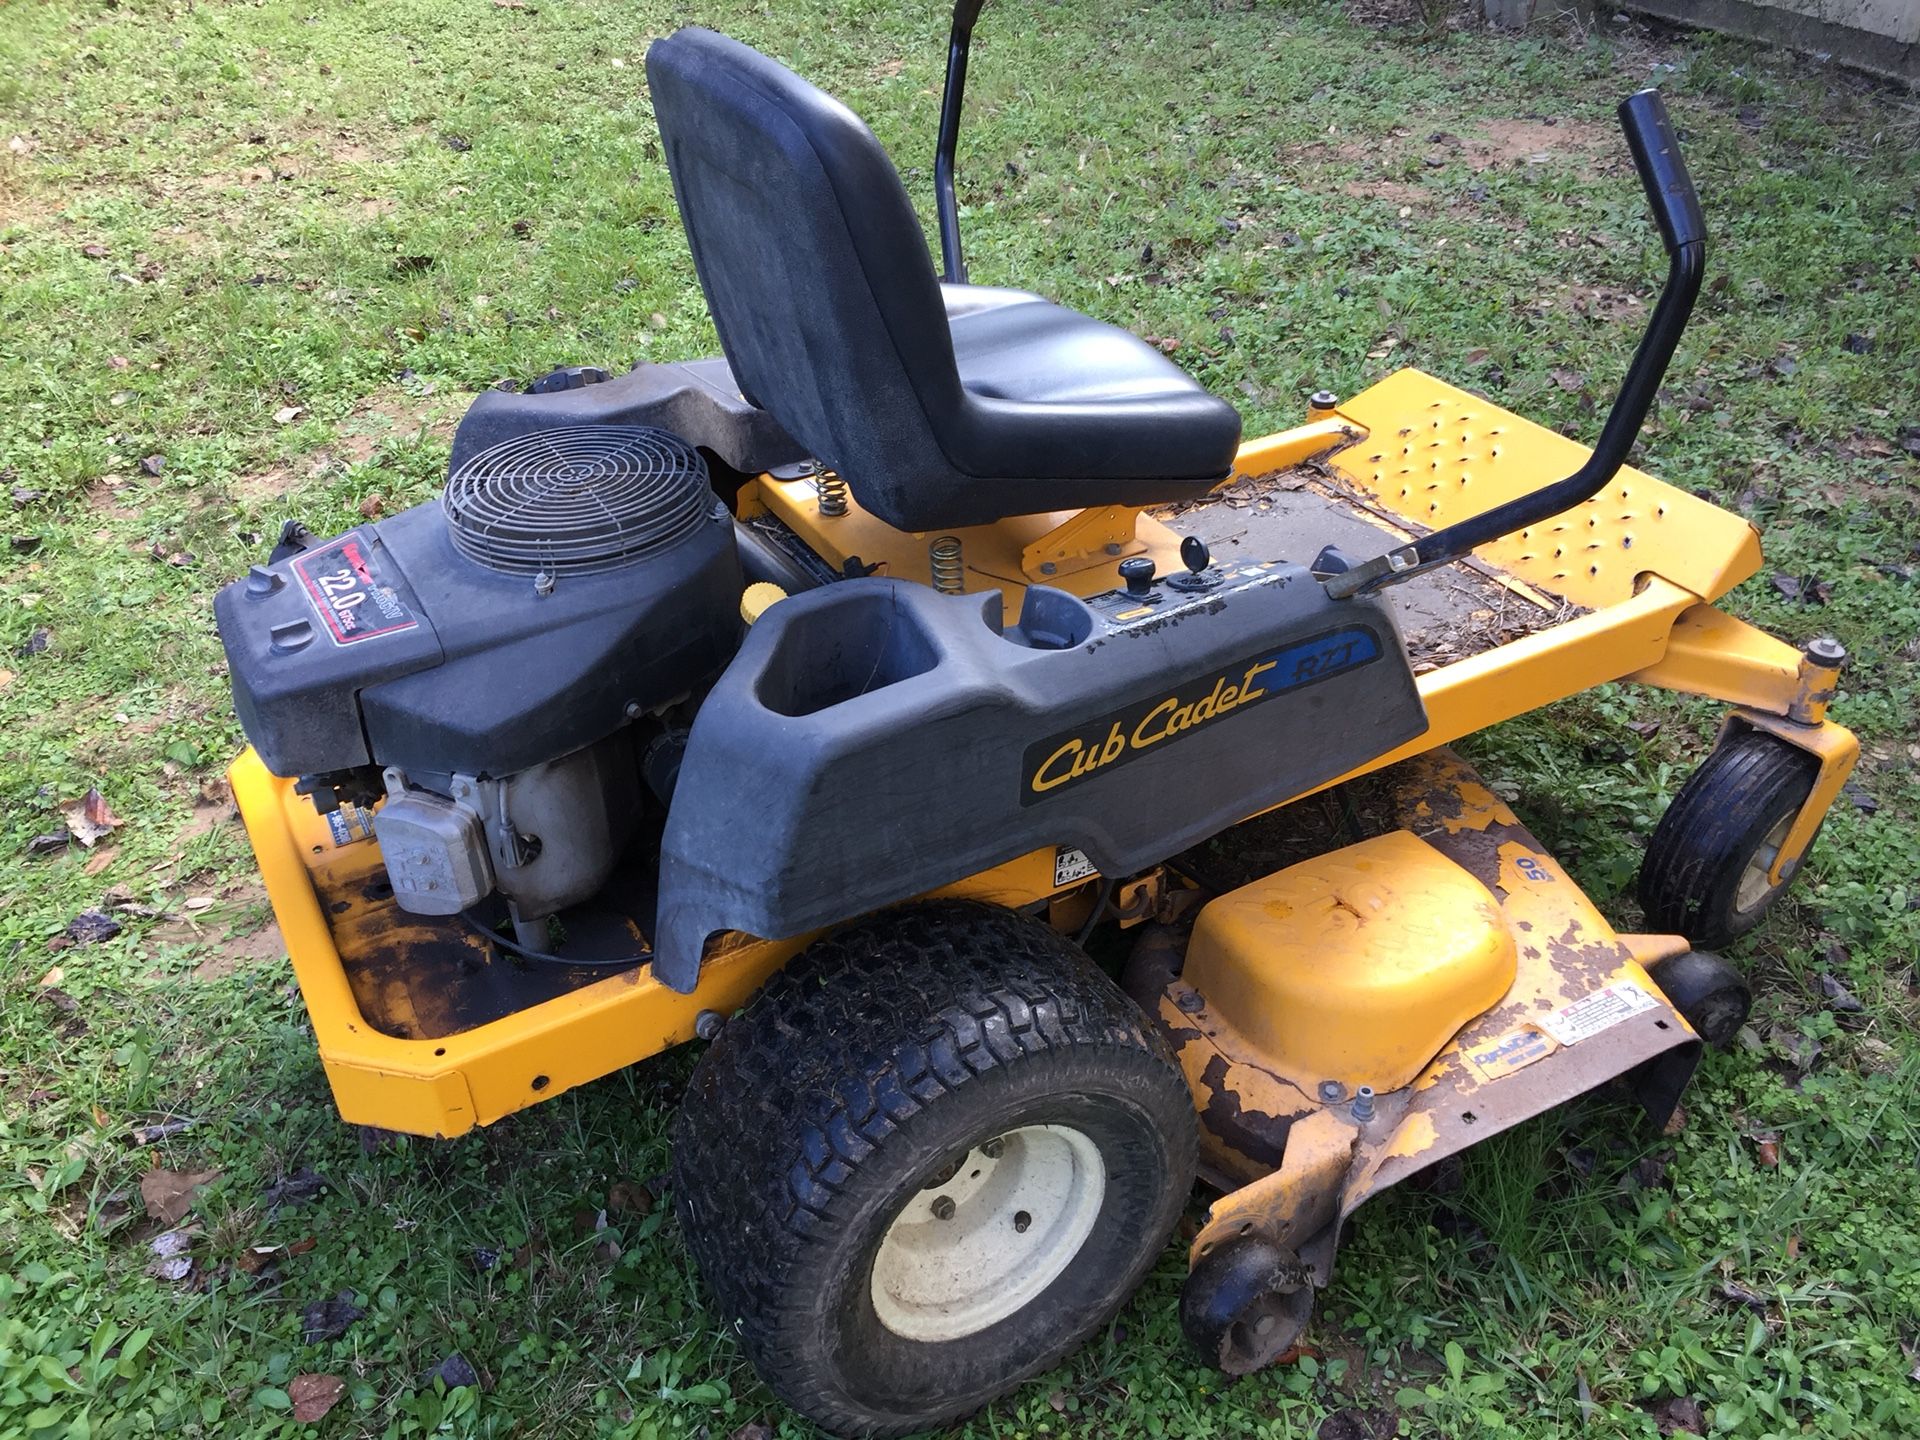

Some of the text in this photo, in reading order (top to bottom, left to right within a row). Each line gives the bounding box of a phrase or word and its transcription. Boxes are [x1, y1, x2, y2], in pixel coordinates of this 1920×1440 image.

[318, 569, 366, 610] 22.0
[1032, 640, 1360, 792] Cub Cadet RZT
[1516, 858, 1546, 880] 50
